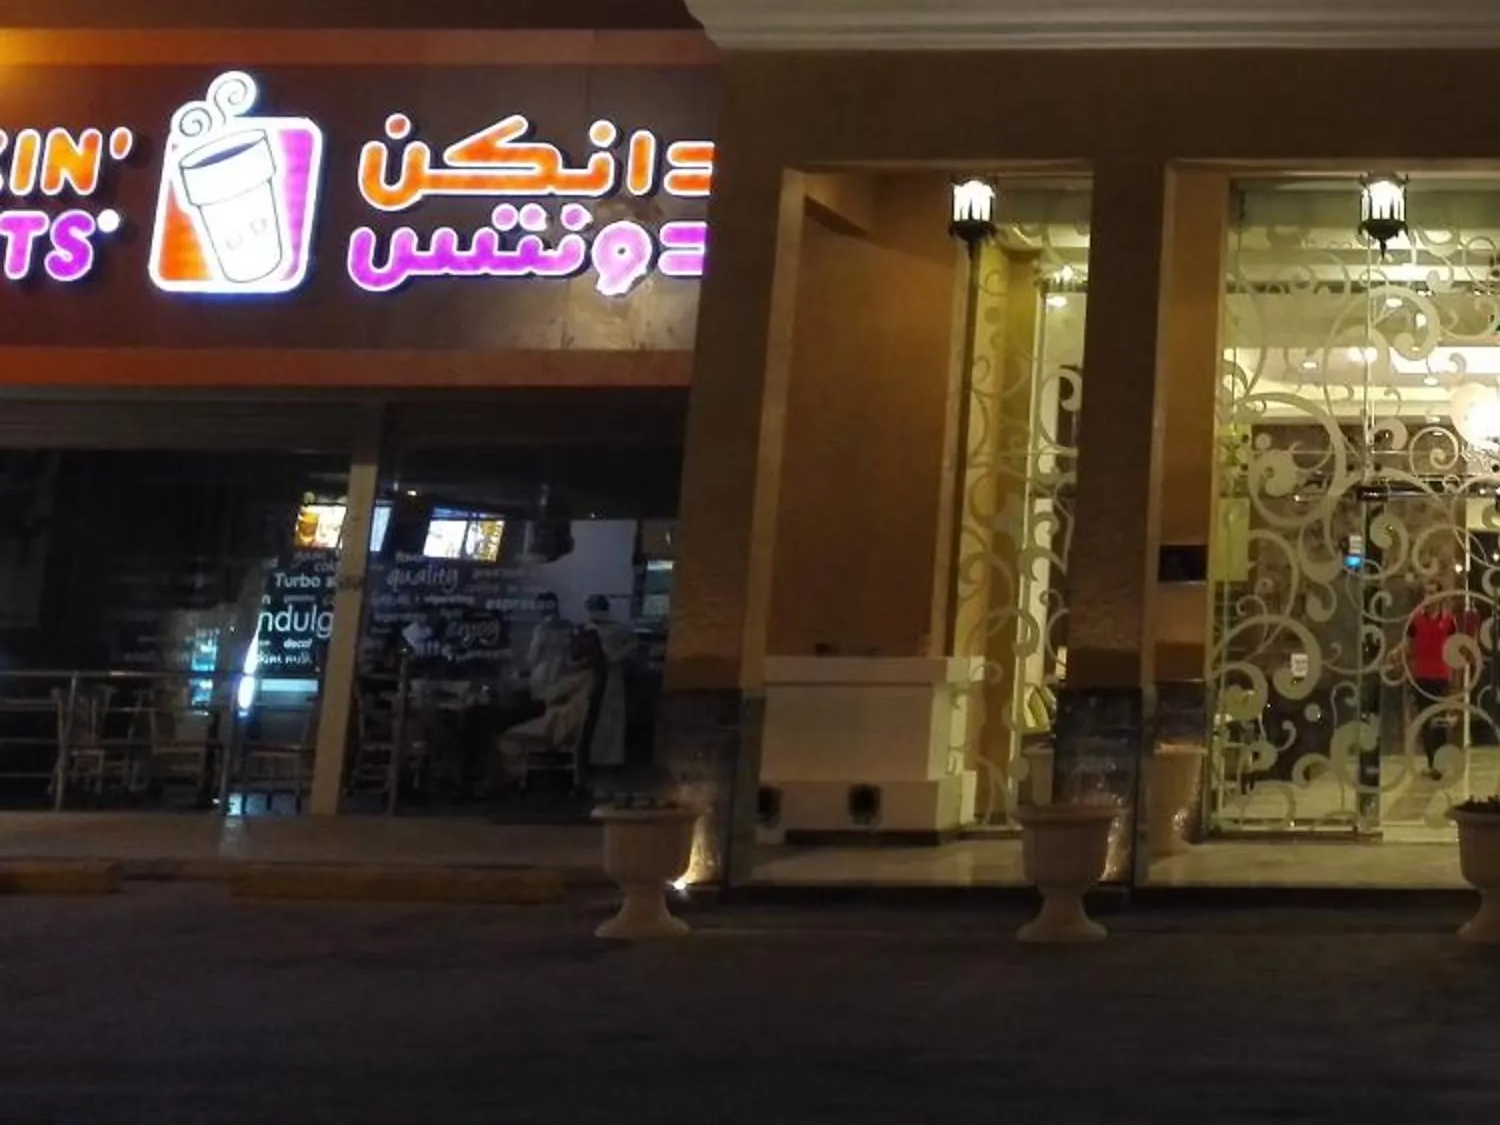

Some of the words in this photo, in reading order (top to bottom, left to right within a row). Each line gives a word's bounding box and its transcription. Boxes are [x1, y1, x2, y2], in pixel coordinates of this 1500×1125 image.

[0, 126, 133, 196] IN'
[273, 571, 321, 589] Turbo
[257, 603, 335, 639] ndulg
